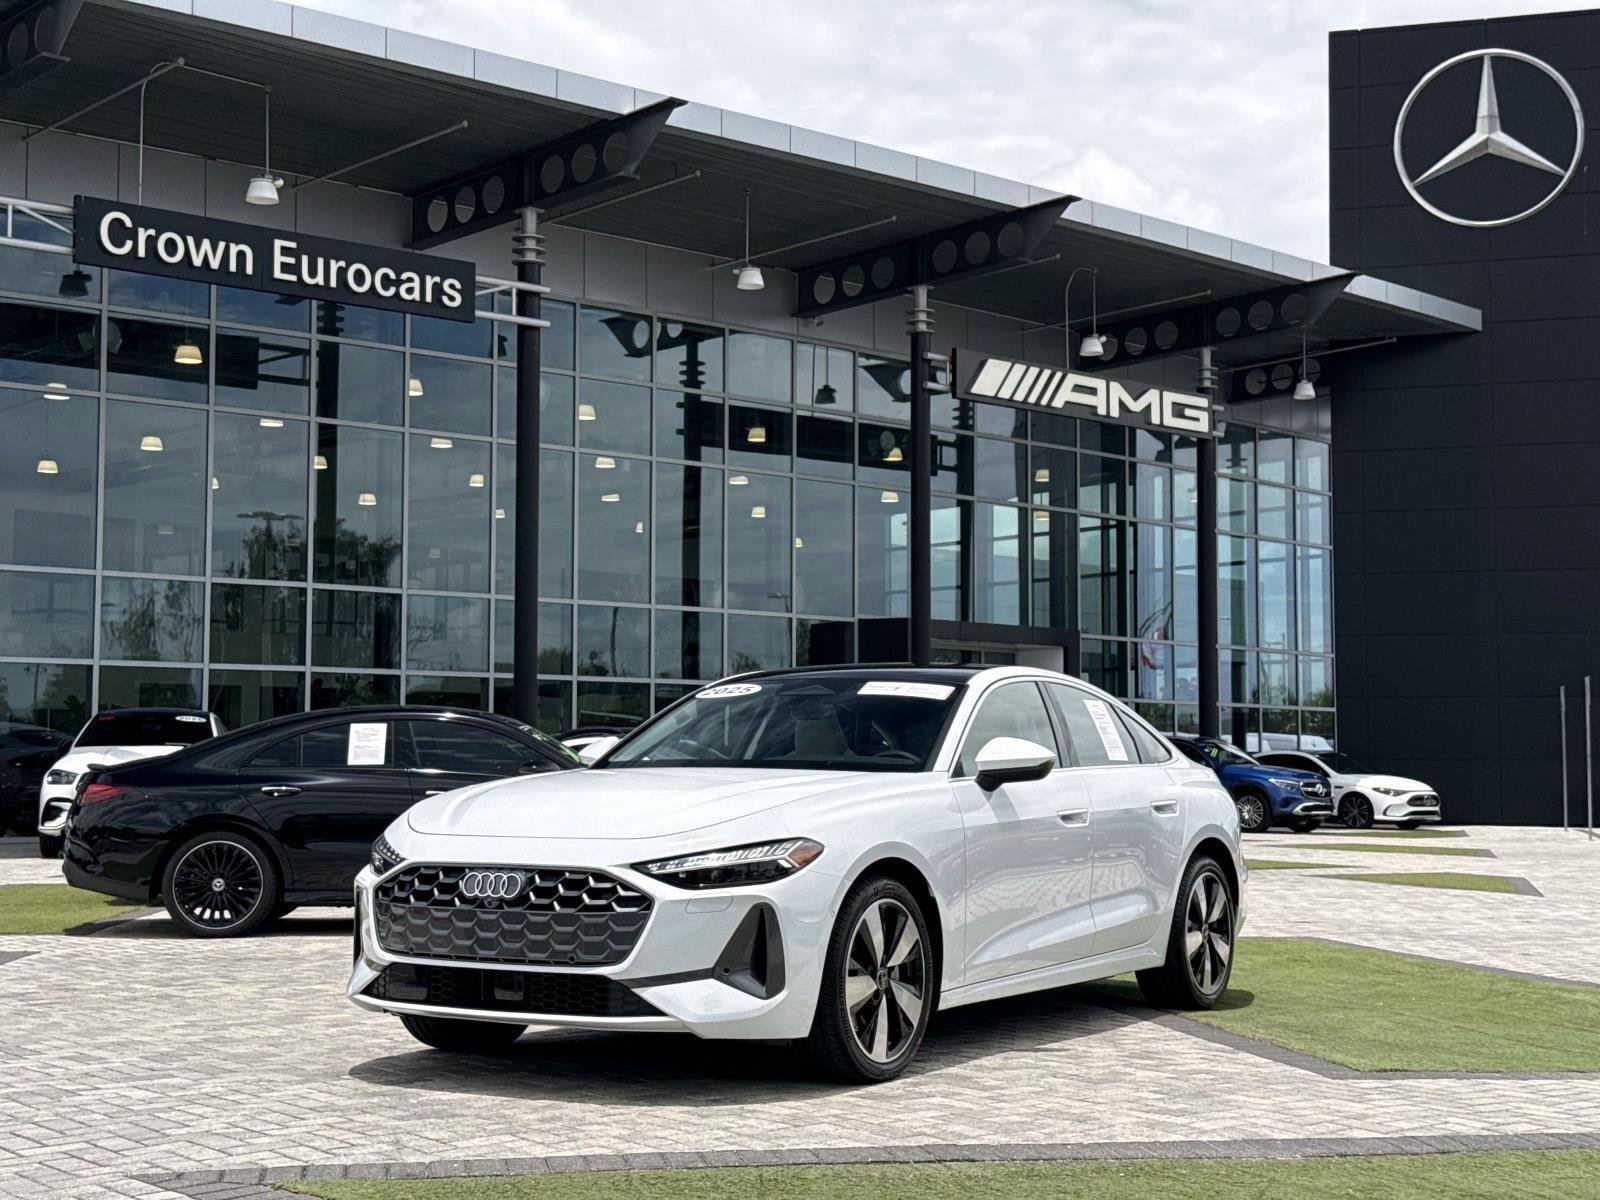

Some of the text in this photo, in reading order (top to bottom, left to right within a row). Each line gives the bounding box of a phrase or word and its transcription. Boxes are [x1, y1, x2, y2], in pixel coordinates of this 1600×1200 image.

[99, 211, 463, 308] Crown Eurocars
[1050, 372, 1210, 434] AMG
[702, 687, 756, 696] 2025
